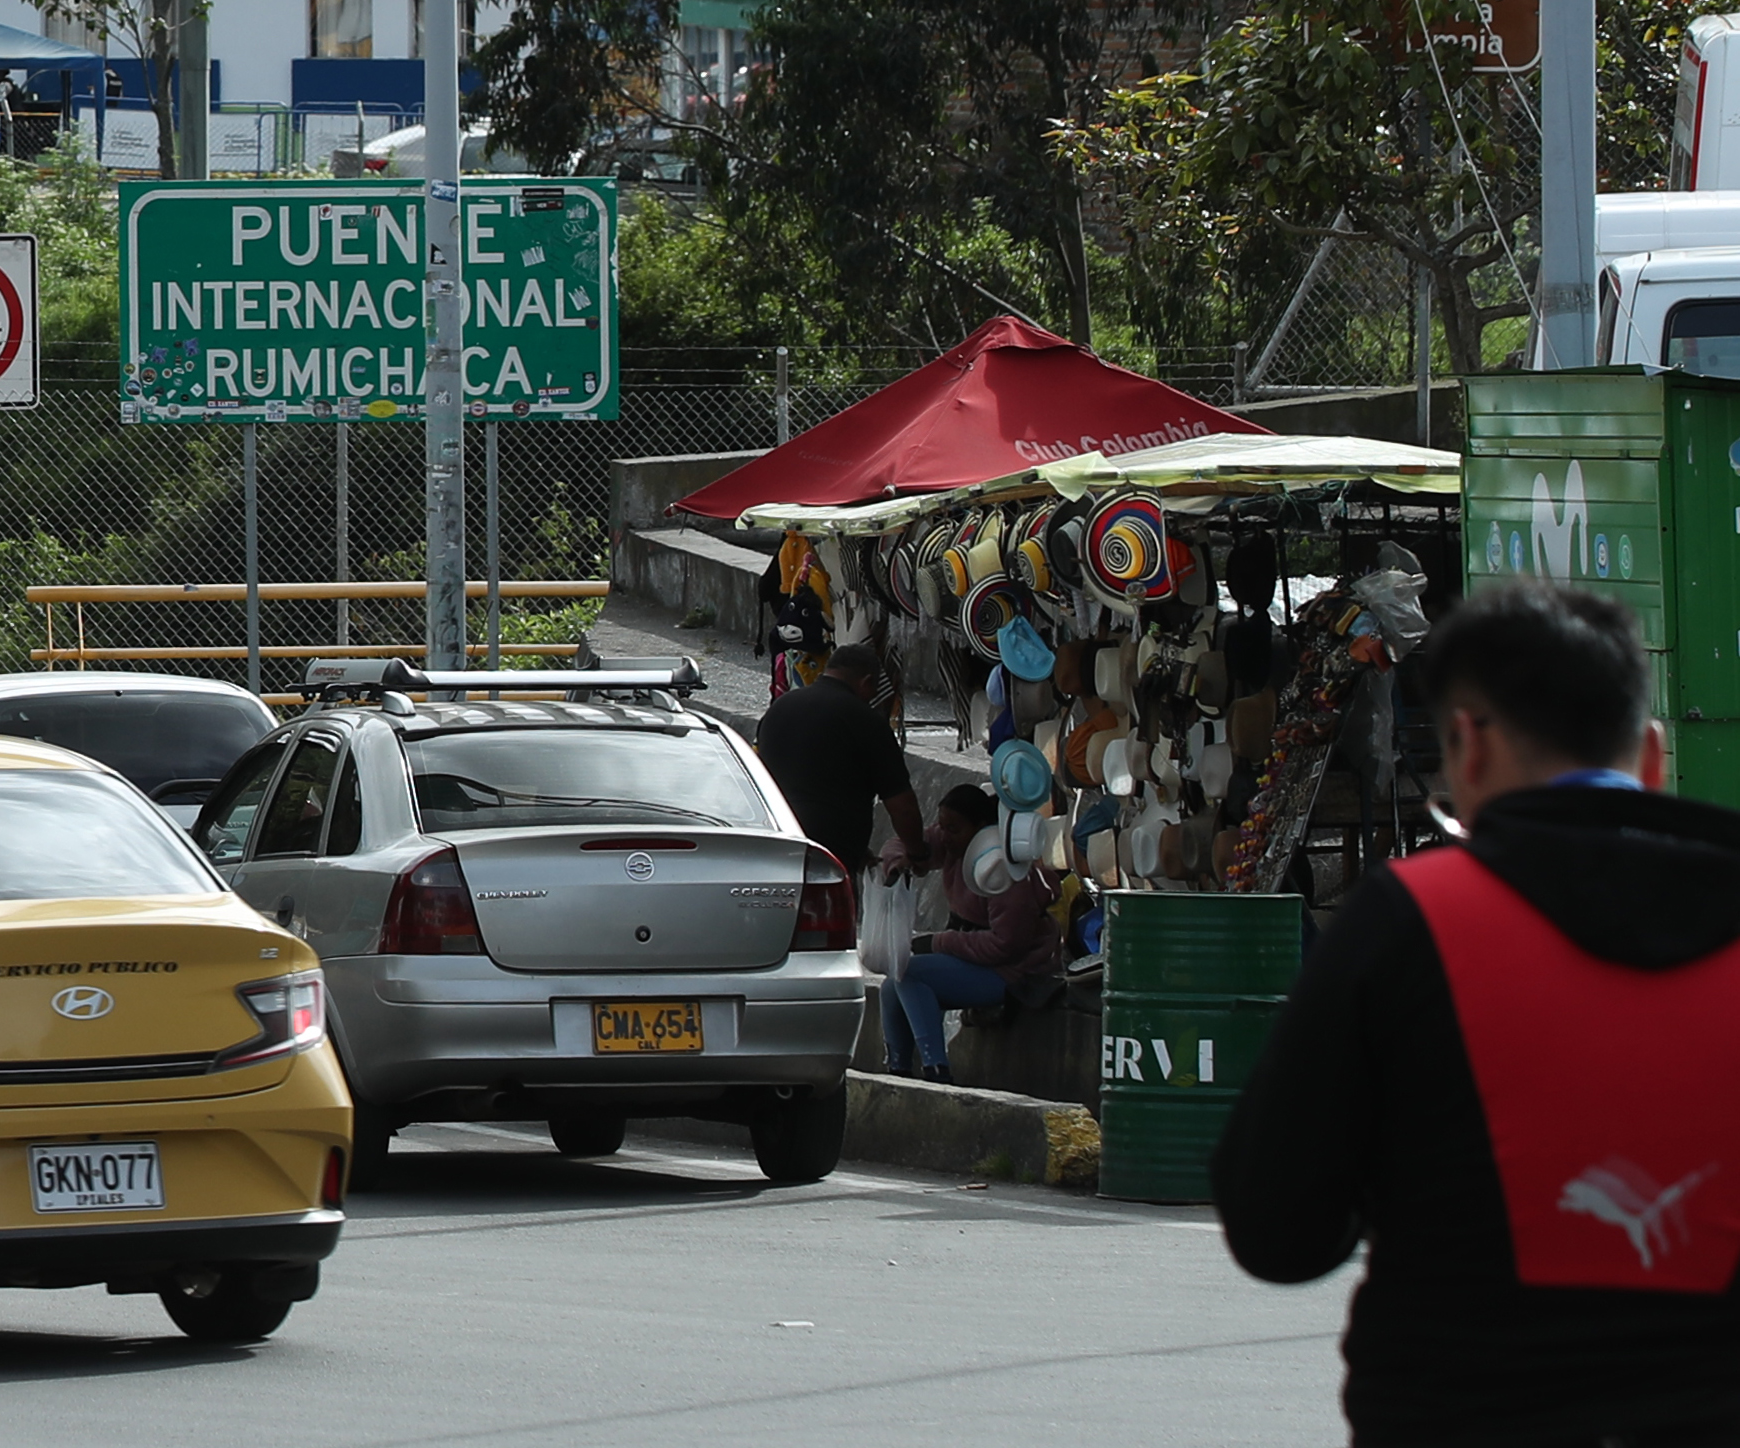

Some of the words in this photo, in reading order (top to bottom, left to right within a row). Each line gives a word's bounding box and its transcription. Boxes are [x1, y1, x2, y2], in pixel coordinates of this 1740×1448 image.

[232, 204, 505, 267] PUENE
[152, 278, 587, 331] INTERNACNAL
[1014, 439, 1073, 462] Club
[1080, 417, 1210, 455] Colombia
[87, 960, 179, 975] PUBLICO
[638, 1040, 661, 1051] CALI
[75, 1193, 125, 1206] IPIALES
